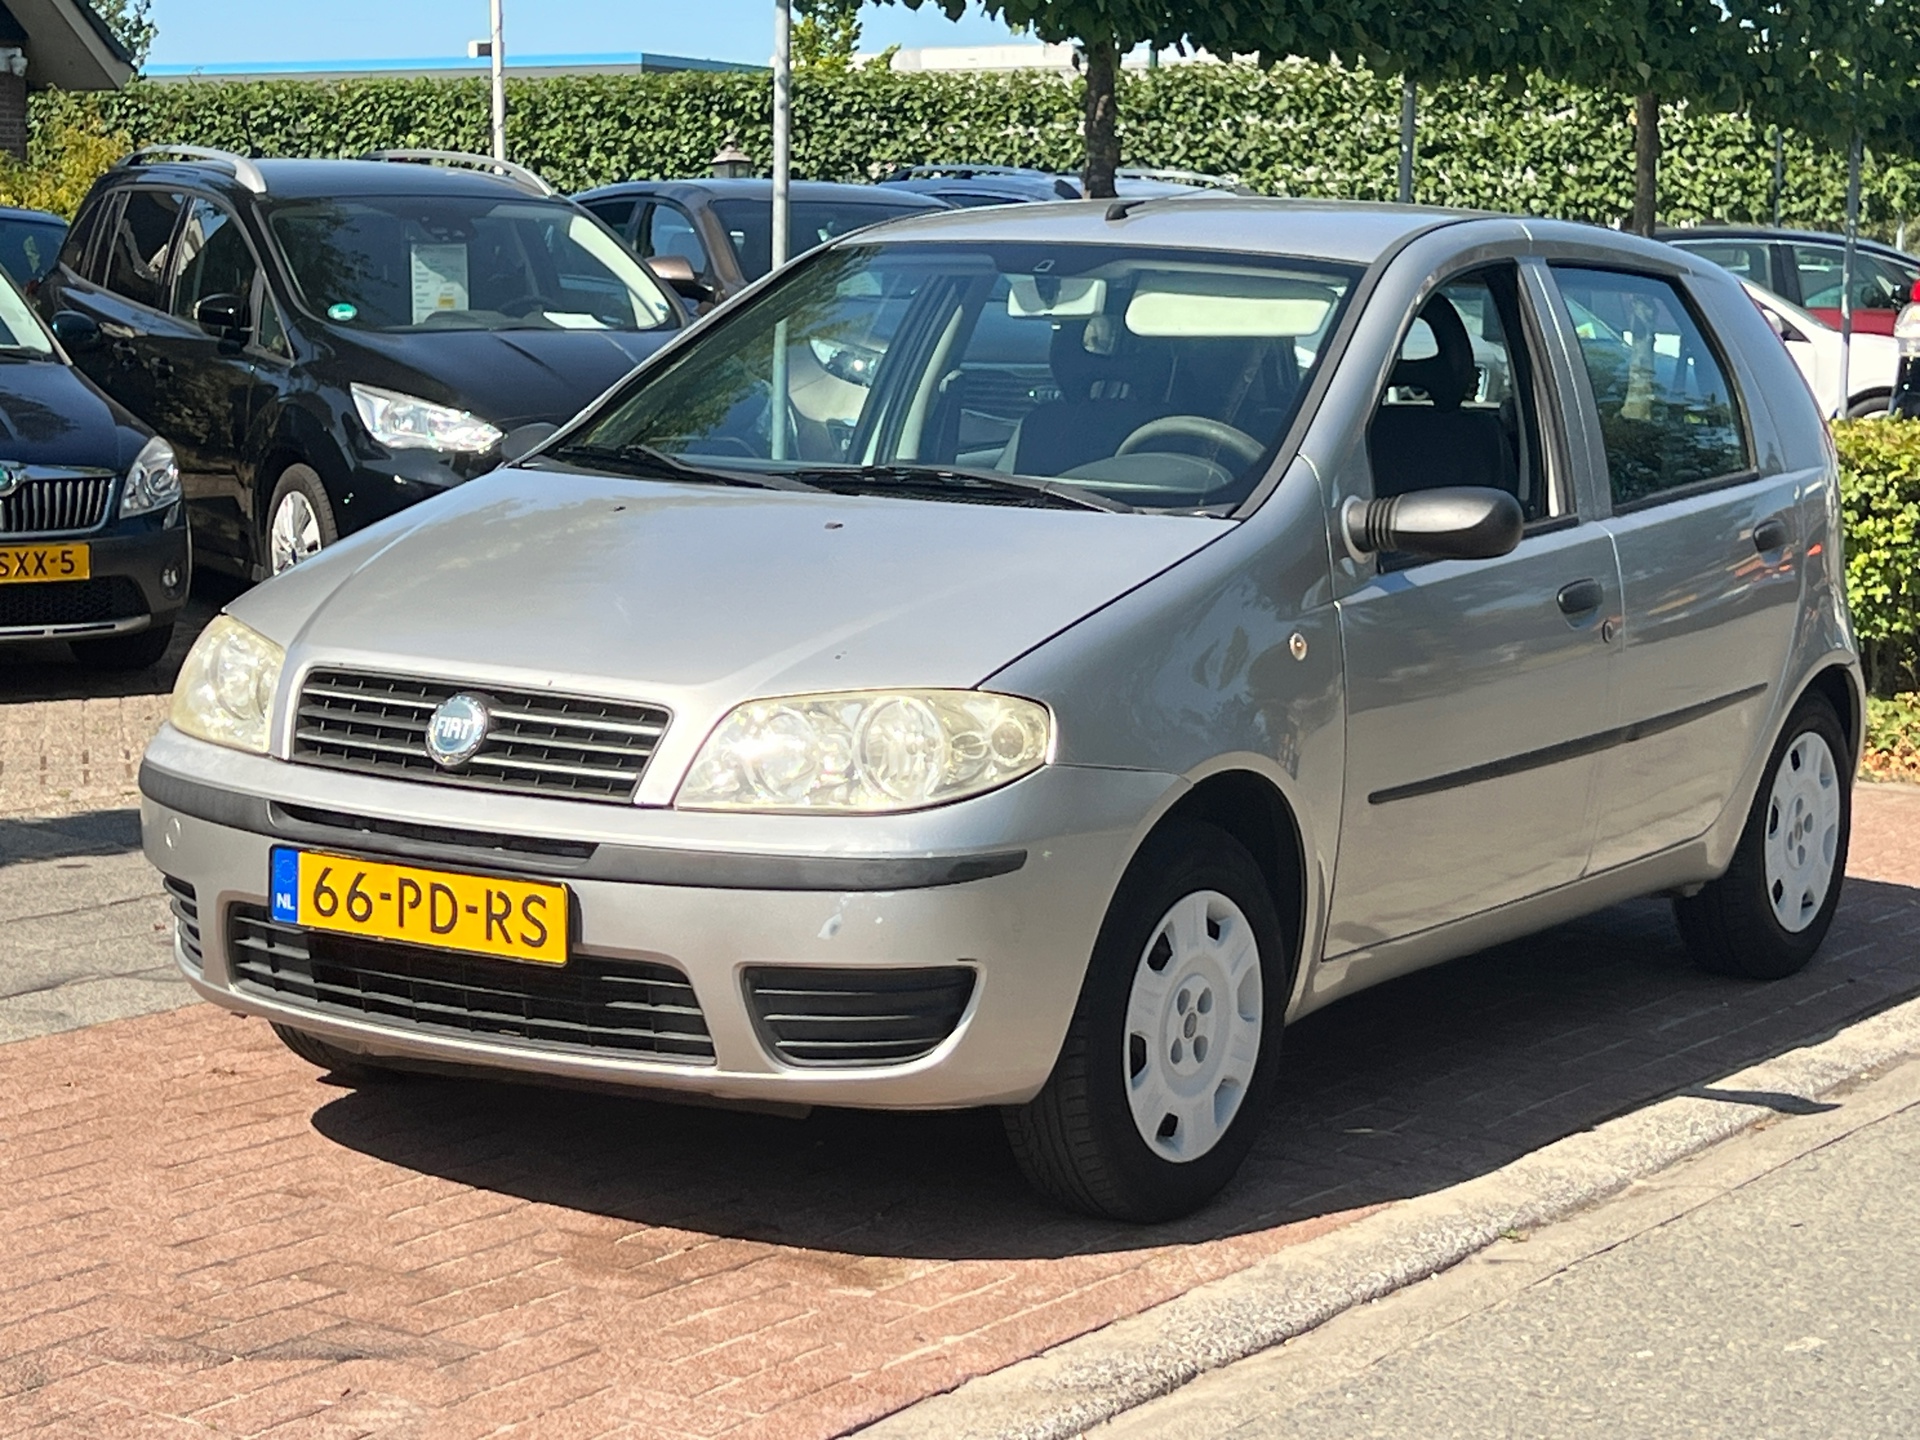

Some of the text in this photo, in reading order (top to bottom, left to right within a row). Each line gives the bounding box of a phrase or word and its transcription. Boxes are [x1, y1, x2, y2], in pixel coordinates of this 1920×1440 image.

[435, 716, 473, 740] FIAT
[276, 892, 296, 910] NL
[313, 867, 548, 948] 66-PD-RS
